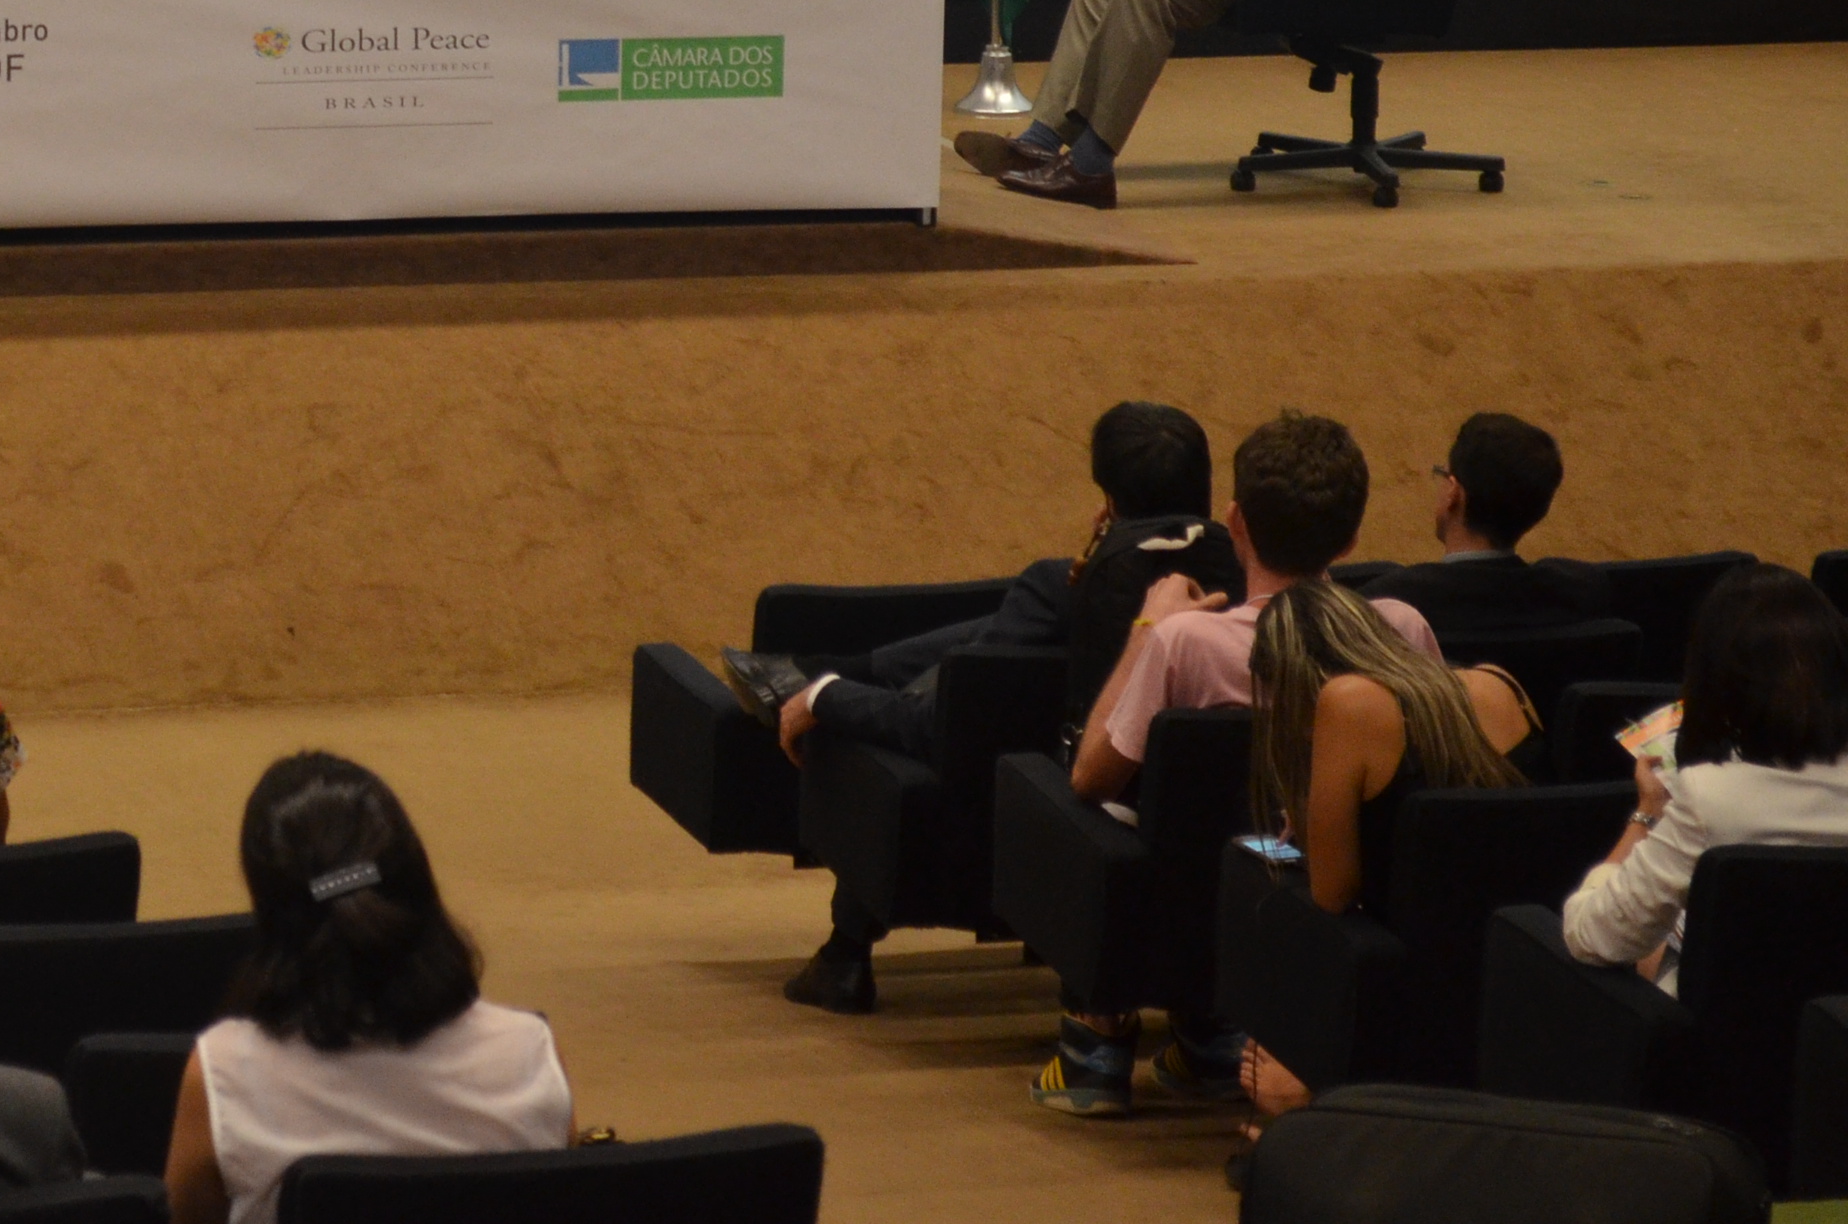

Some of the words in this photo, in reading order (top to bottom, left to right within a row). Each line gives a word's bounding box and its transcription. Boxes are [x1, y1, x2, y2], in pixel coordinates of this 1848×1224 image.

[301, 27, 398, 52] Global
[413, 27, 489, 50] Peace
[632, 44, 723, 67] CÂMARA
[729, 46, 773, 65] DOS
[283, 64, 380, 75] LEADERSHIP
[387, 62, 489, 72] CONFERENCE
[633, 68, 772, 90] DEPUTADOS
[326, 96, 425, 109] BRASIL
